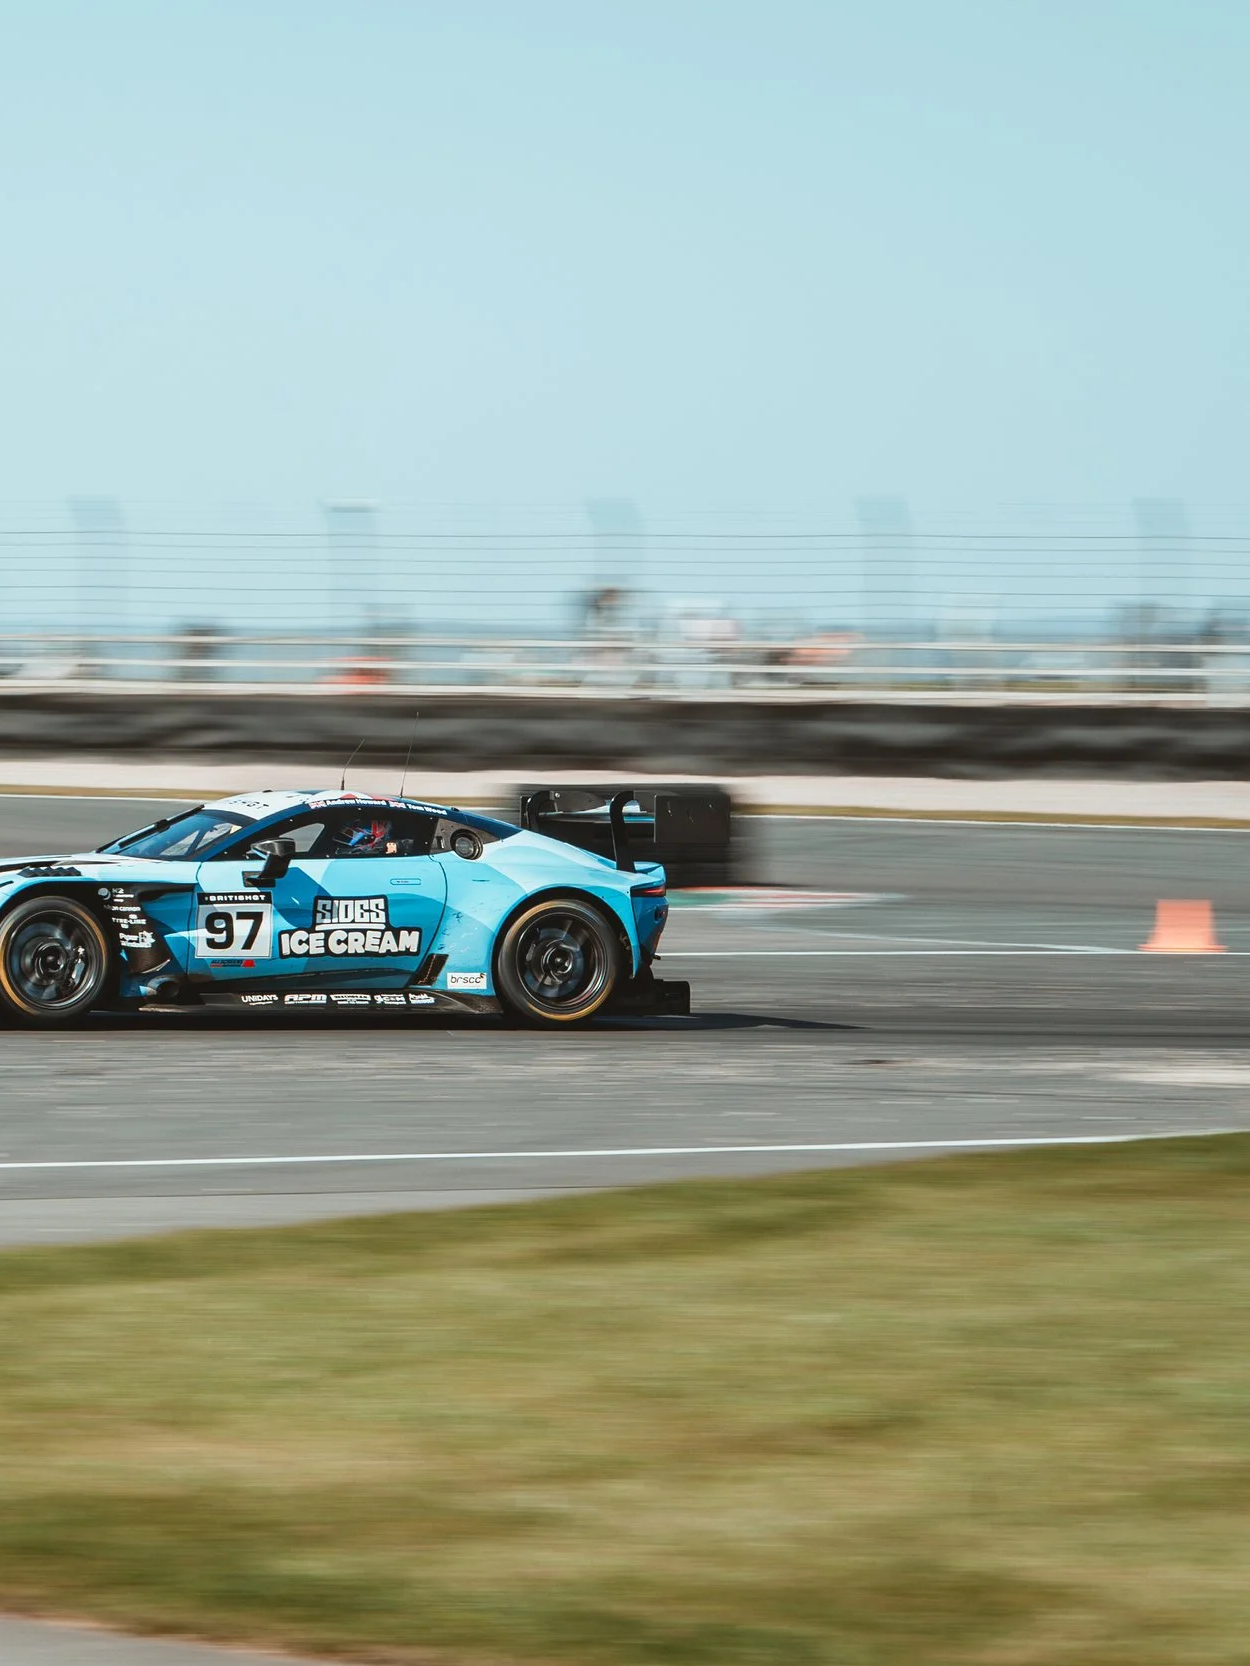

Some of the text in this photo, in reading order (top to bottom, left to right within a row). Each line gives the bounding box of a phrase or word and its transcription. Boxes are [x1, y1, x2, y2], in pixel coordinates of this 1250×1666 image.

[315, 898, 386, 923] SIDES
[205, 911, 264, 950] 97
[280, 930, 420, 955] ICE CREAM
[450, 974, 481, 984] brscc
